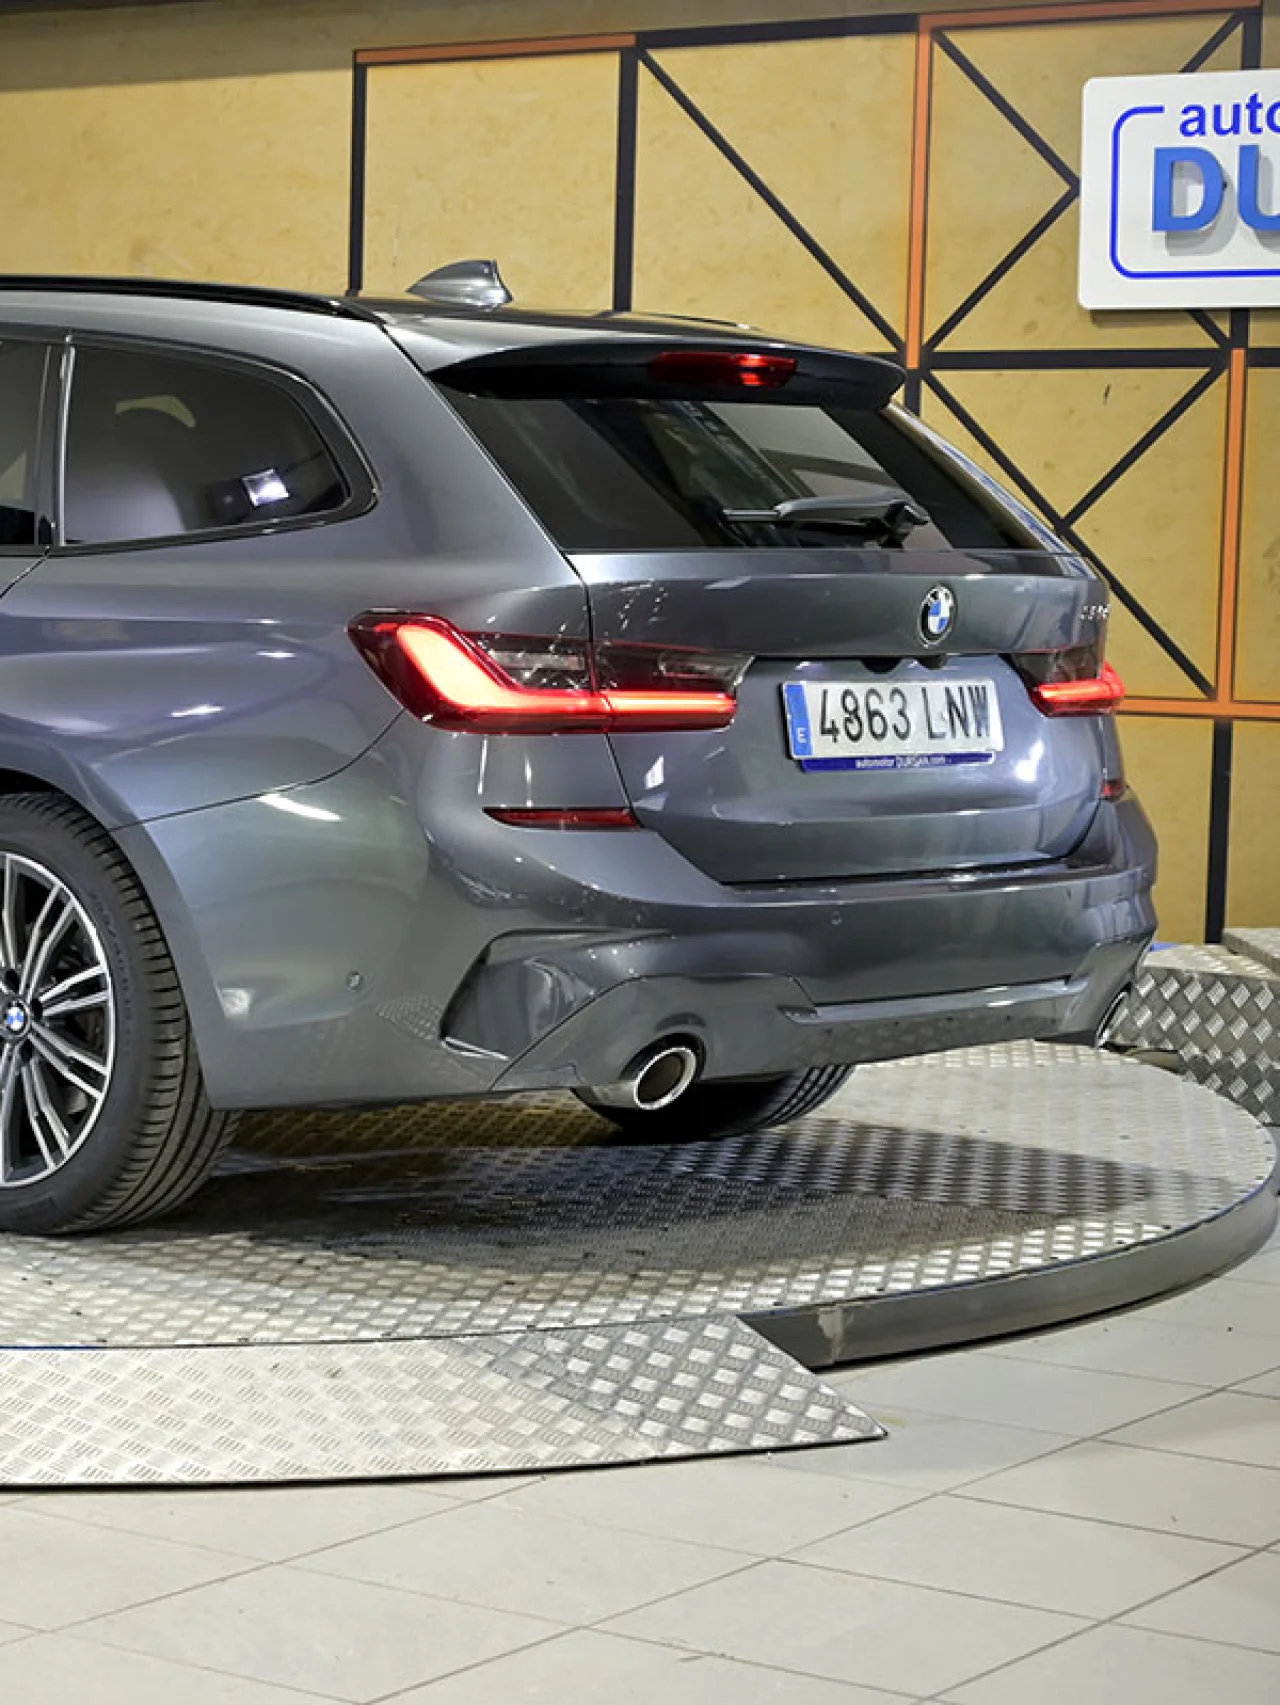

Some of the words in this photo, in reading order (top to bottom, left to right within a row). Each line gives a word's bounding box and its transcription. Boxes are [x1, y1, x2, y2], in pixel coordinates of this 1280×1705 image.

[820, 687, 911, 743] 4863
[921, 684, 991, 740] LNW
[797, 727, 808, 744] E
